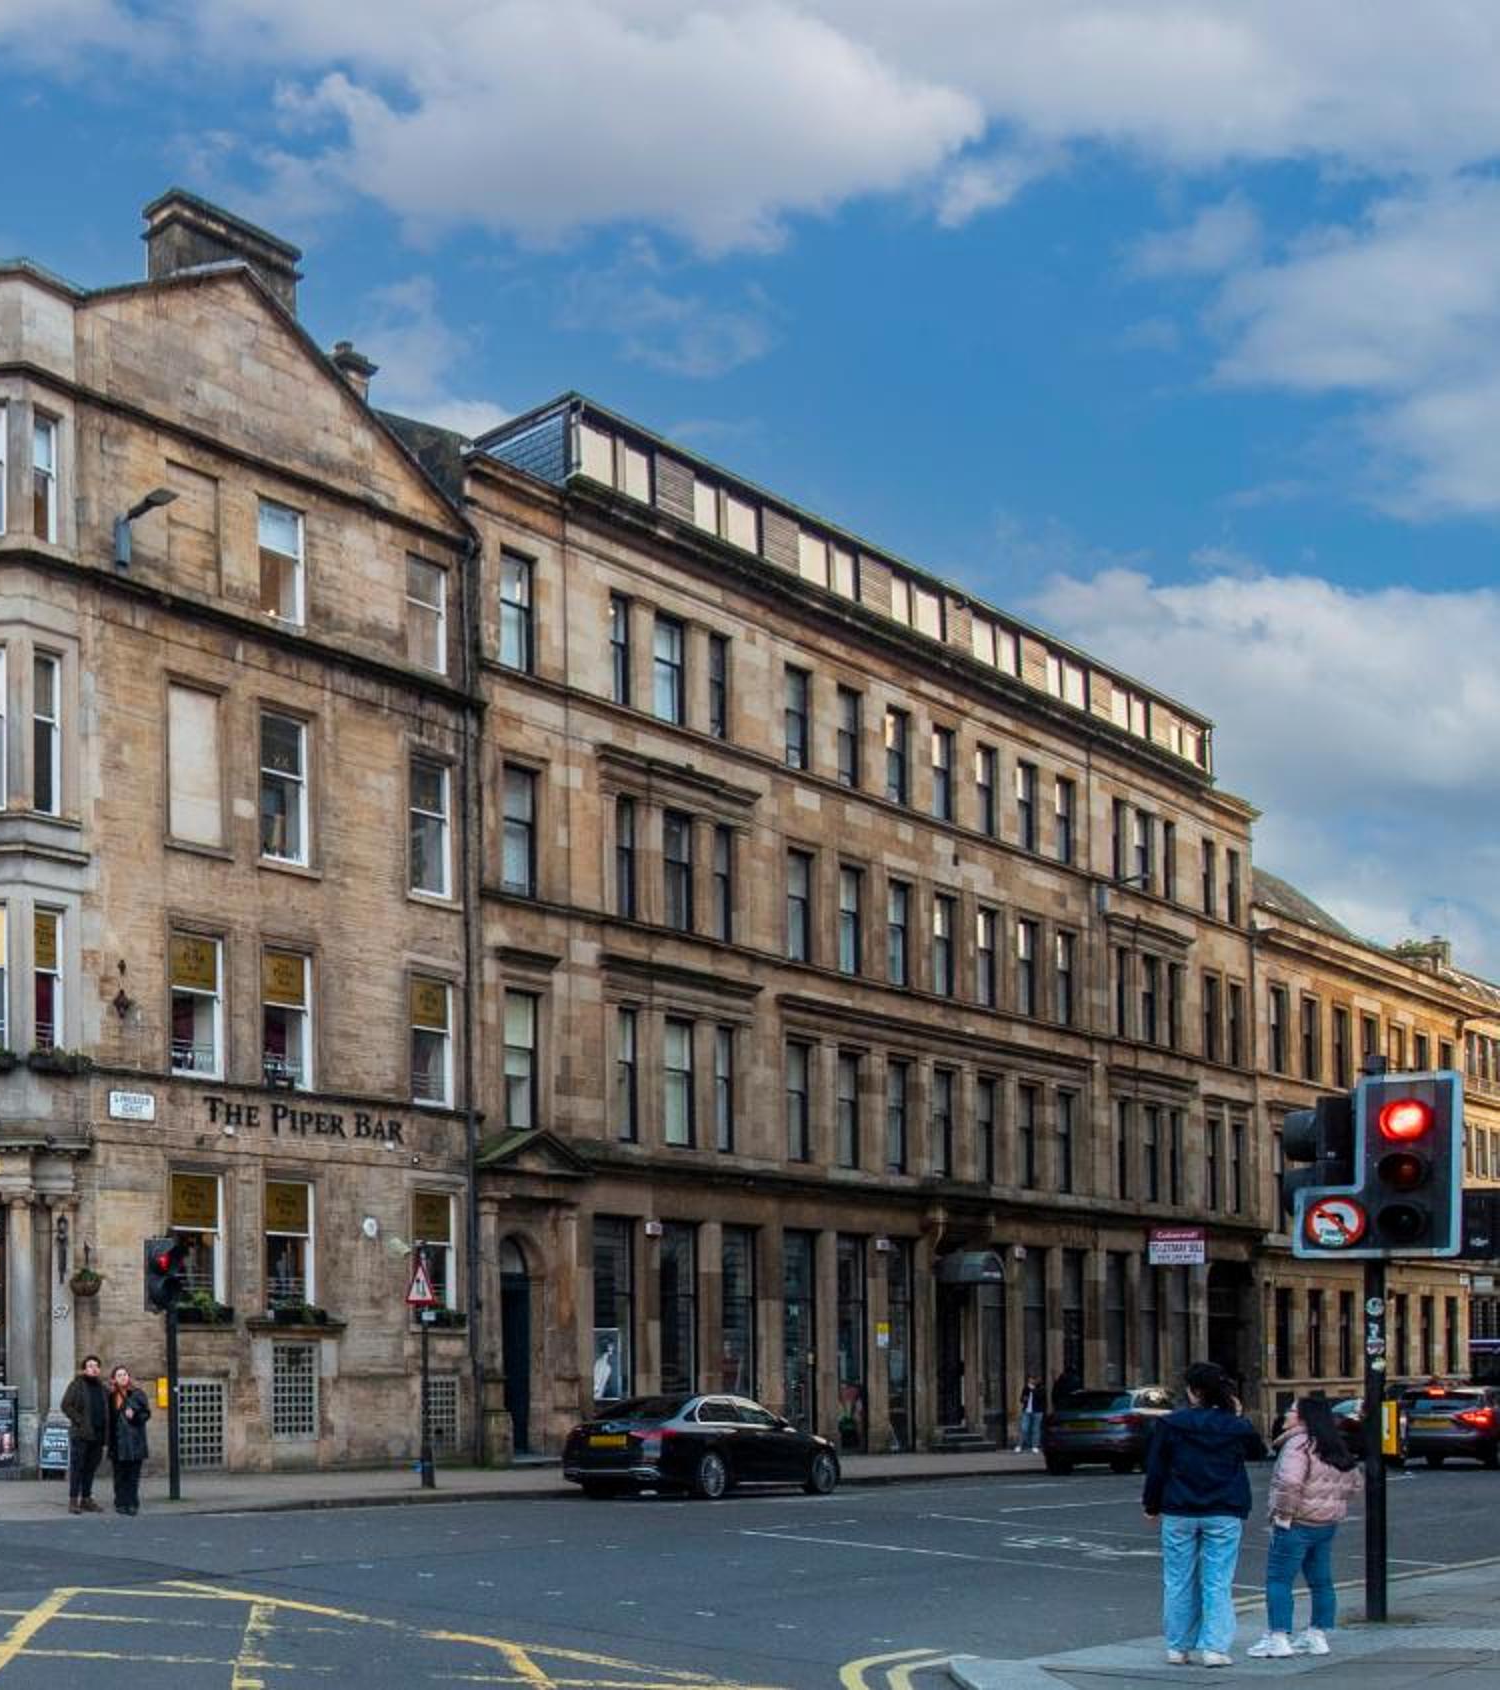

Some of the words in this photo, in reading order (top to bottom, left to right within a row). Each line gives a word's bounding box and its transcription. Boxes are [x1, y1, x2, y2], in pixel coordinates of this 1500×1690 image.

[203, 1096, 260, 1127] THE
[271, 1104, 346, 1137] PIPER
[354, 1111, 404, 1145] BAR
